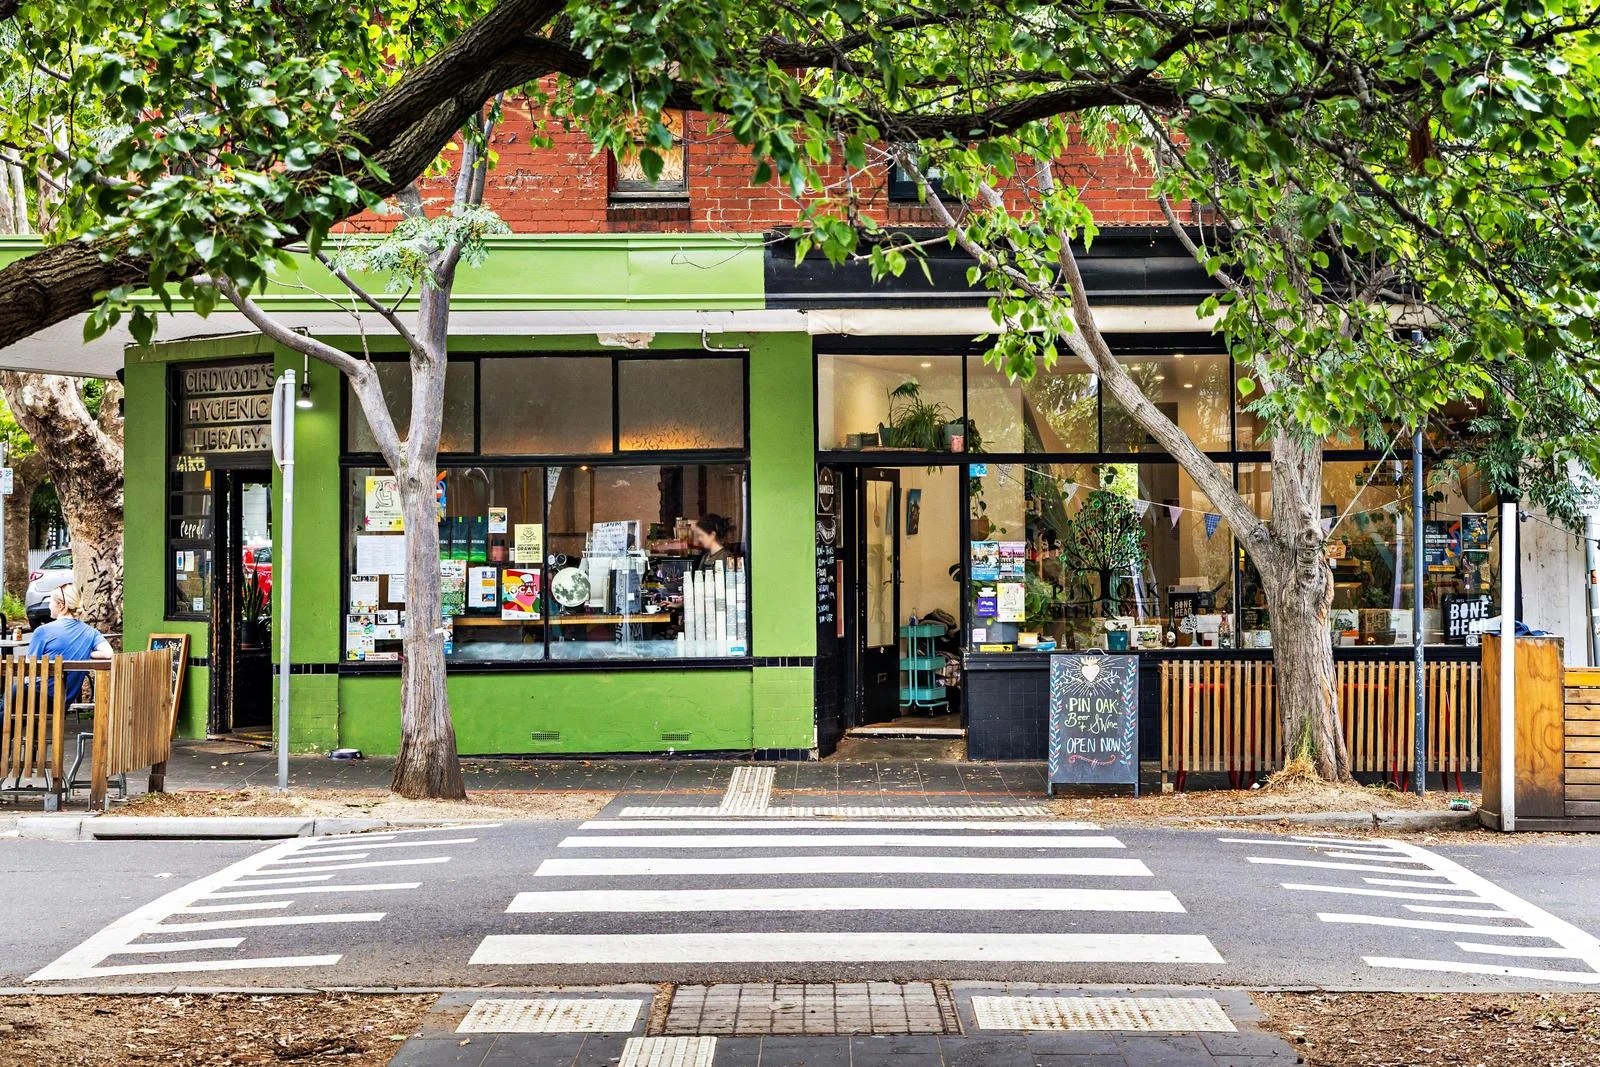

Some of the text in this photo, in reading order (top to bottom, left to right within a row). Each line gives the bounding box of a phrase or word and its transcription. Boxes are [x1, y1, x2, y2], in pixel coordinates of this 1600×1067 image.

[188, 397, 269, 421] HYGIENIC
[508, 585, 538, 594] LOCAL
[1051, 581, 1161, 600] PIN OAK
[1174, 600, 1193, 609] BONE
[1450, 602, 1489, 620] BONE
[1069, 697, 1117, 713] PIN OAK
[1064, 712, 1090, 727] Beer
[1067, 737, 1120, 753] OPEN NOW
